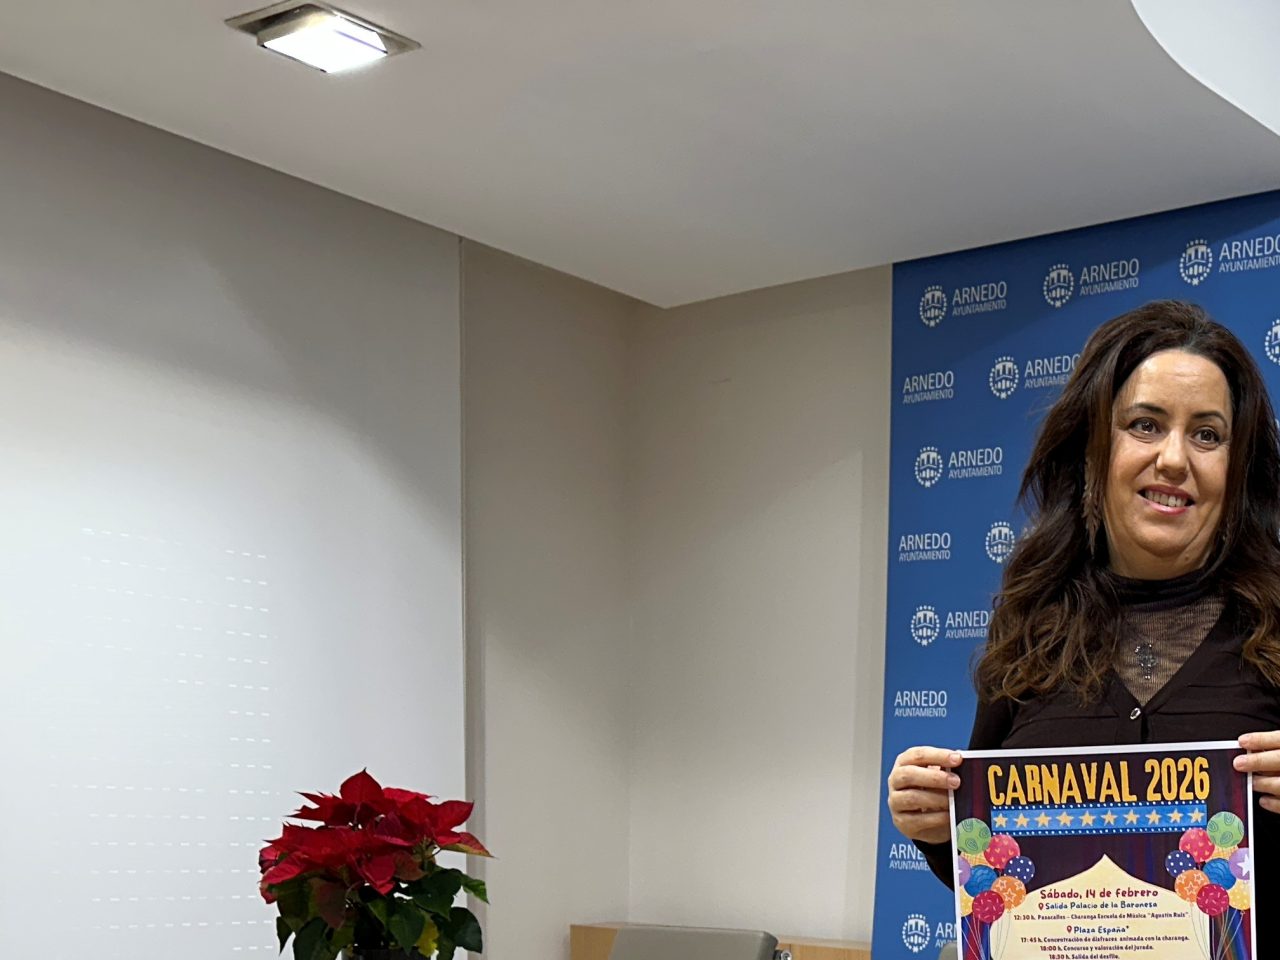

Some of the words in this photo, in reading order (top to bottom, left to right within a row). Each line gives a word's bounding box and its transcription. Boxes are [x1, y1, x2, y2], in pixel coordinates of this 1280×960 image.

[1080, 258, 1140, 284] ARNEDO
[952, 281, 1007, 305] ARNEDO
[1080, 278, 1139, 297] AYUNTAMIENTO
[952, 299, 1006, 317] AYUNTAMIENTO
[903, 370, 954, 393] ARNEDO
[1024, 374, 1069, 389] AYUNTAMIE
[902, 389, 954, 404] AYUNTAMIENTO
[948, 447, 1003, 469] ARNEDO
[948, 465, 1002, 480] AYUNTAMIENTO
[899, 532, 951, 552] ARNEDO
[899, 547, 951, 561] AYUNTAMIENTO
[945, 610, 990, 628] ARNED
[945, 628, 988, 639] AYUNTAMIE
[894, 690, 947, 708] ARNEDO
[894, 704, 947, 717] AYUNTAMIENTO
[988, 761, 1137, 805] CARNAVAL
[1145, 757, 1210, 802] 2026
[889, 843, 924, 860] ARNE
[889, 860, 930, 871] AYUNTAMIE
[1040, 888, 1082, 899] Sábado,
[1086, 889, 1096, 899] 14
[1099, 888, 1112, 898] de
[1116, 887, 1158, 898] febrero
[1045, 902, 1068, 910] Salida
[1100, 901, 1109, 909] de
[1120, 901, 1157, 909] Baronesa
[1074, 926, 1096, 934] Plaza
